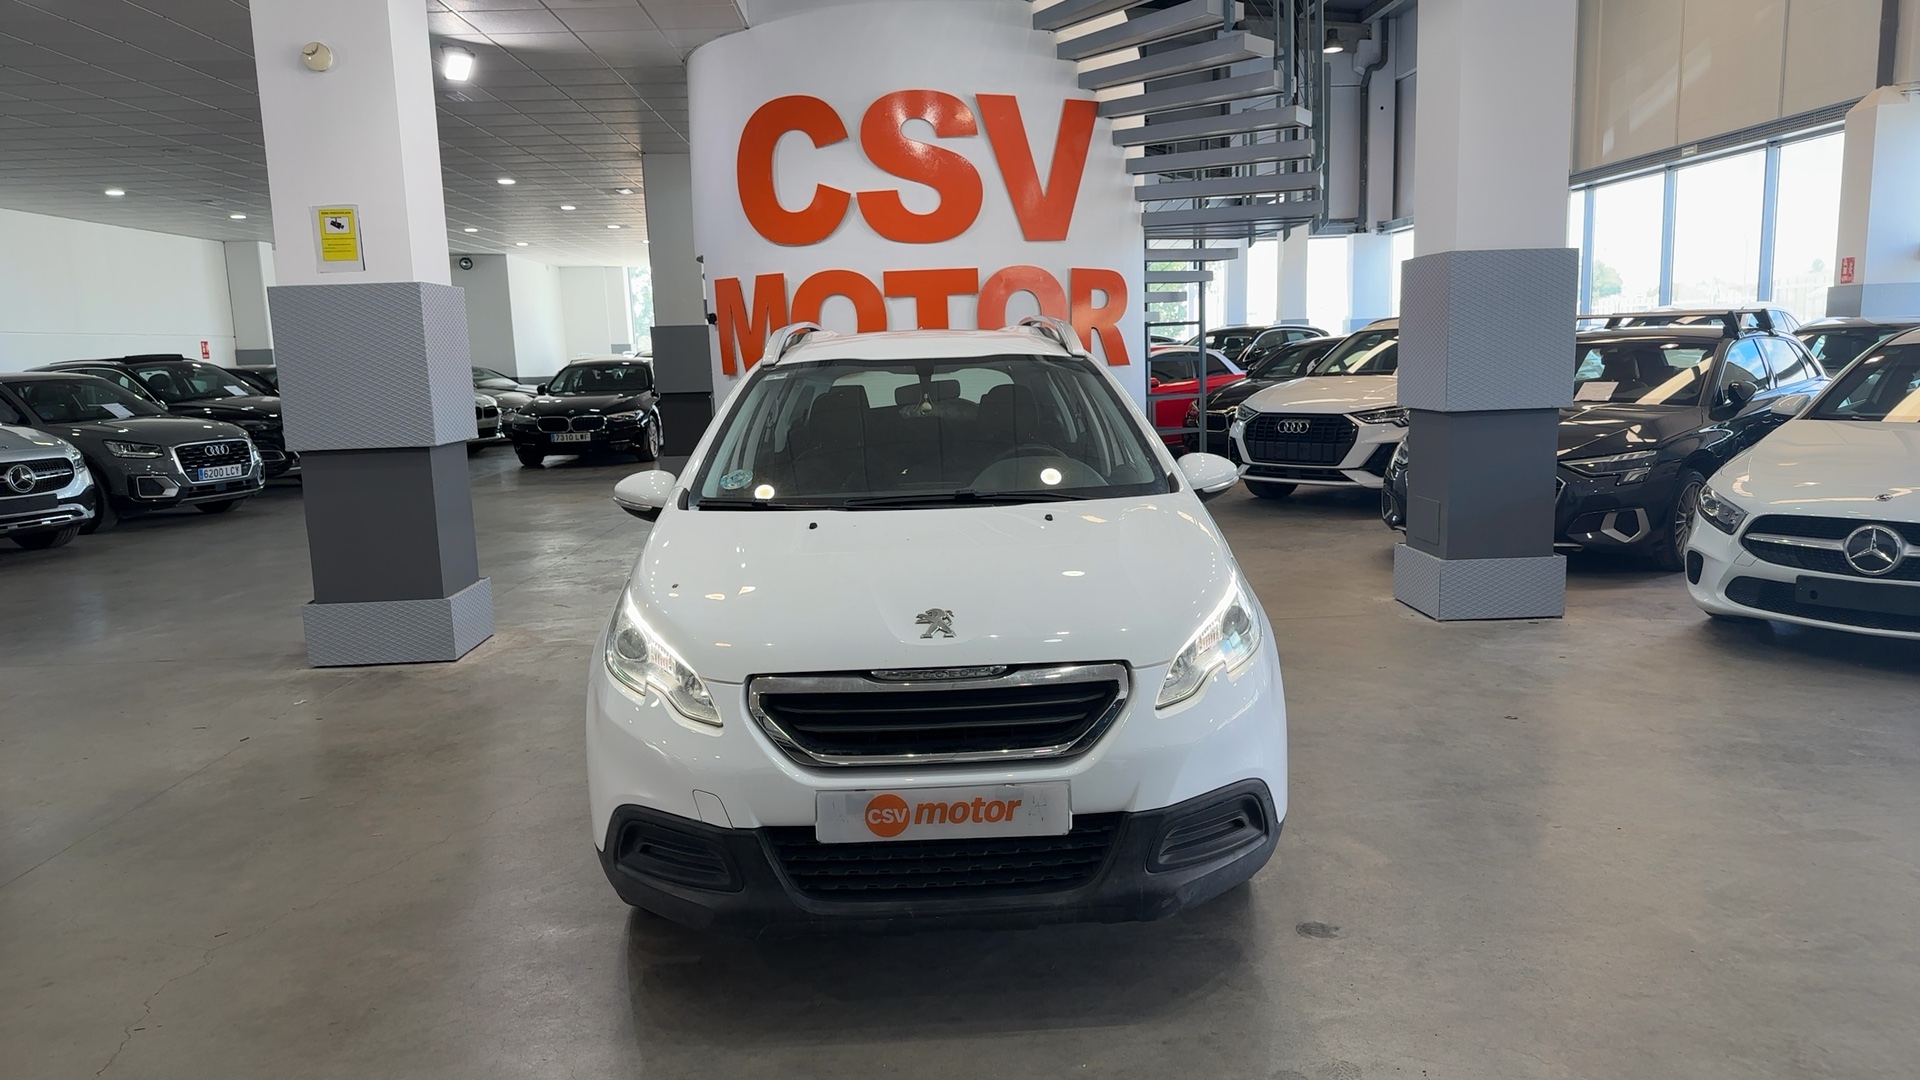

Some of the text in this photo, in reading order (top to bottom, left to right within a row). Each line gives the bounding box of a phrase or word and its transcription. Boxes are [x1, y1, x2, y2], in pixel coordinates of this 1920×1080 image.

[737, 89, 1099, 247] CSV
[714, 265, 1131, 376] MOTOR
[555, 434, 573, 442] 7310
[204, 466, 240, 479] 6200 LCY
[867, 797, 1022, 825] CSV motor
